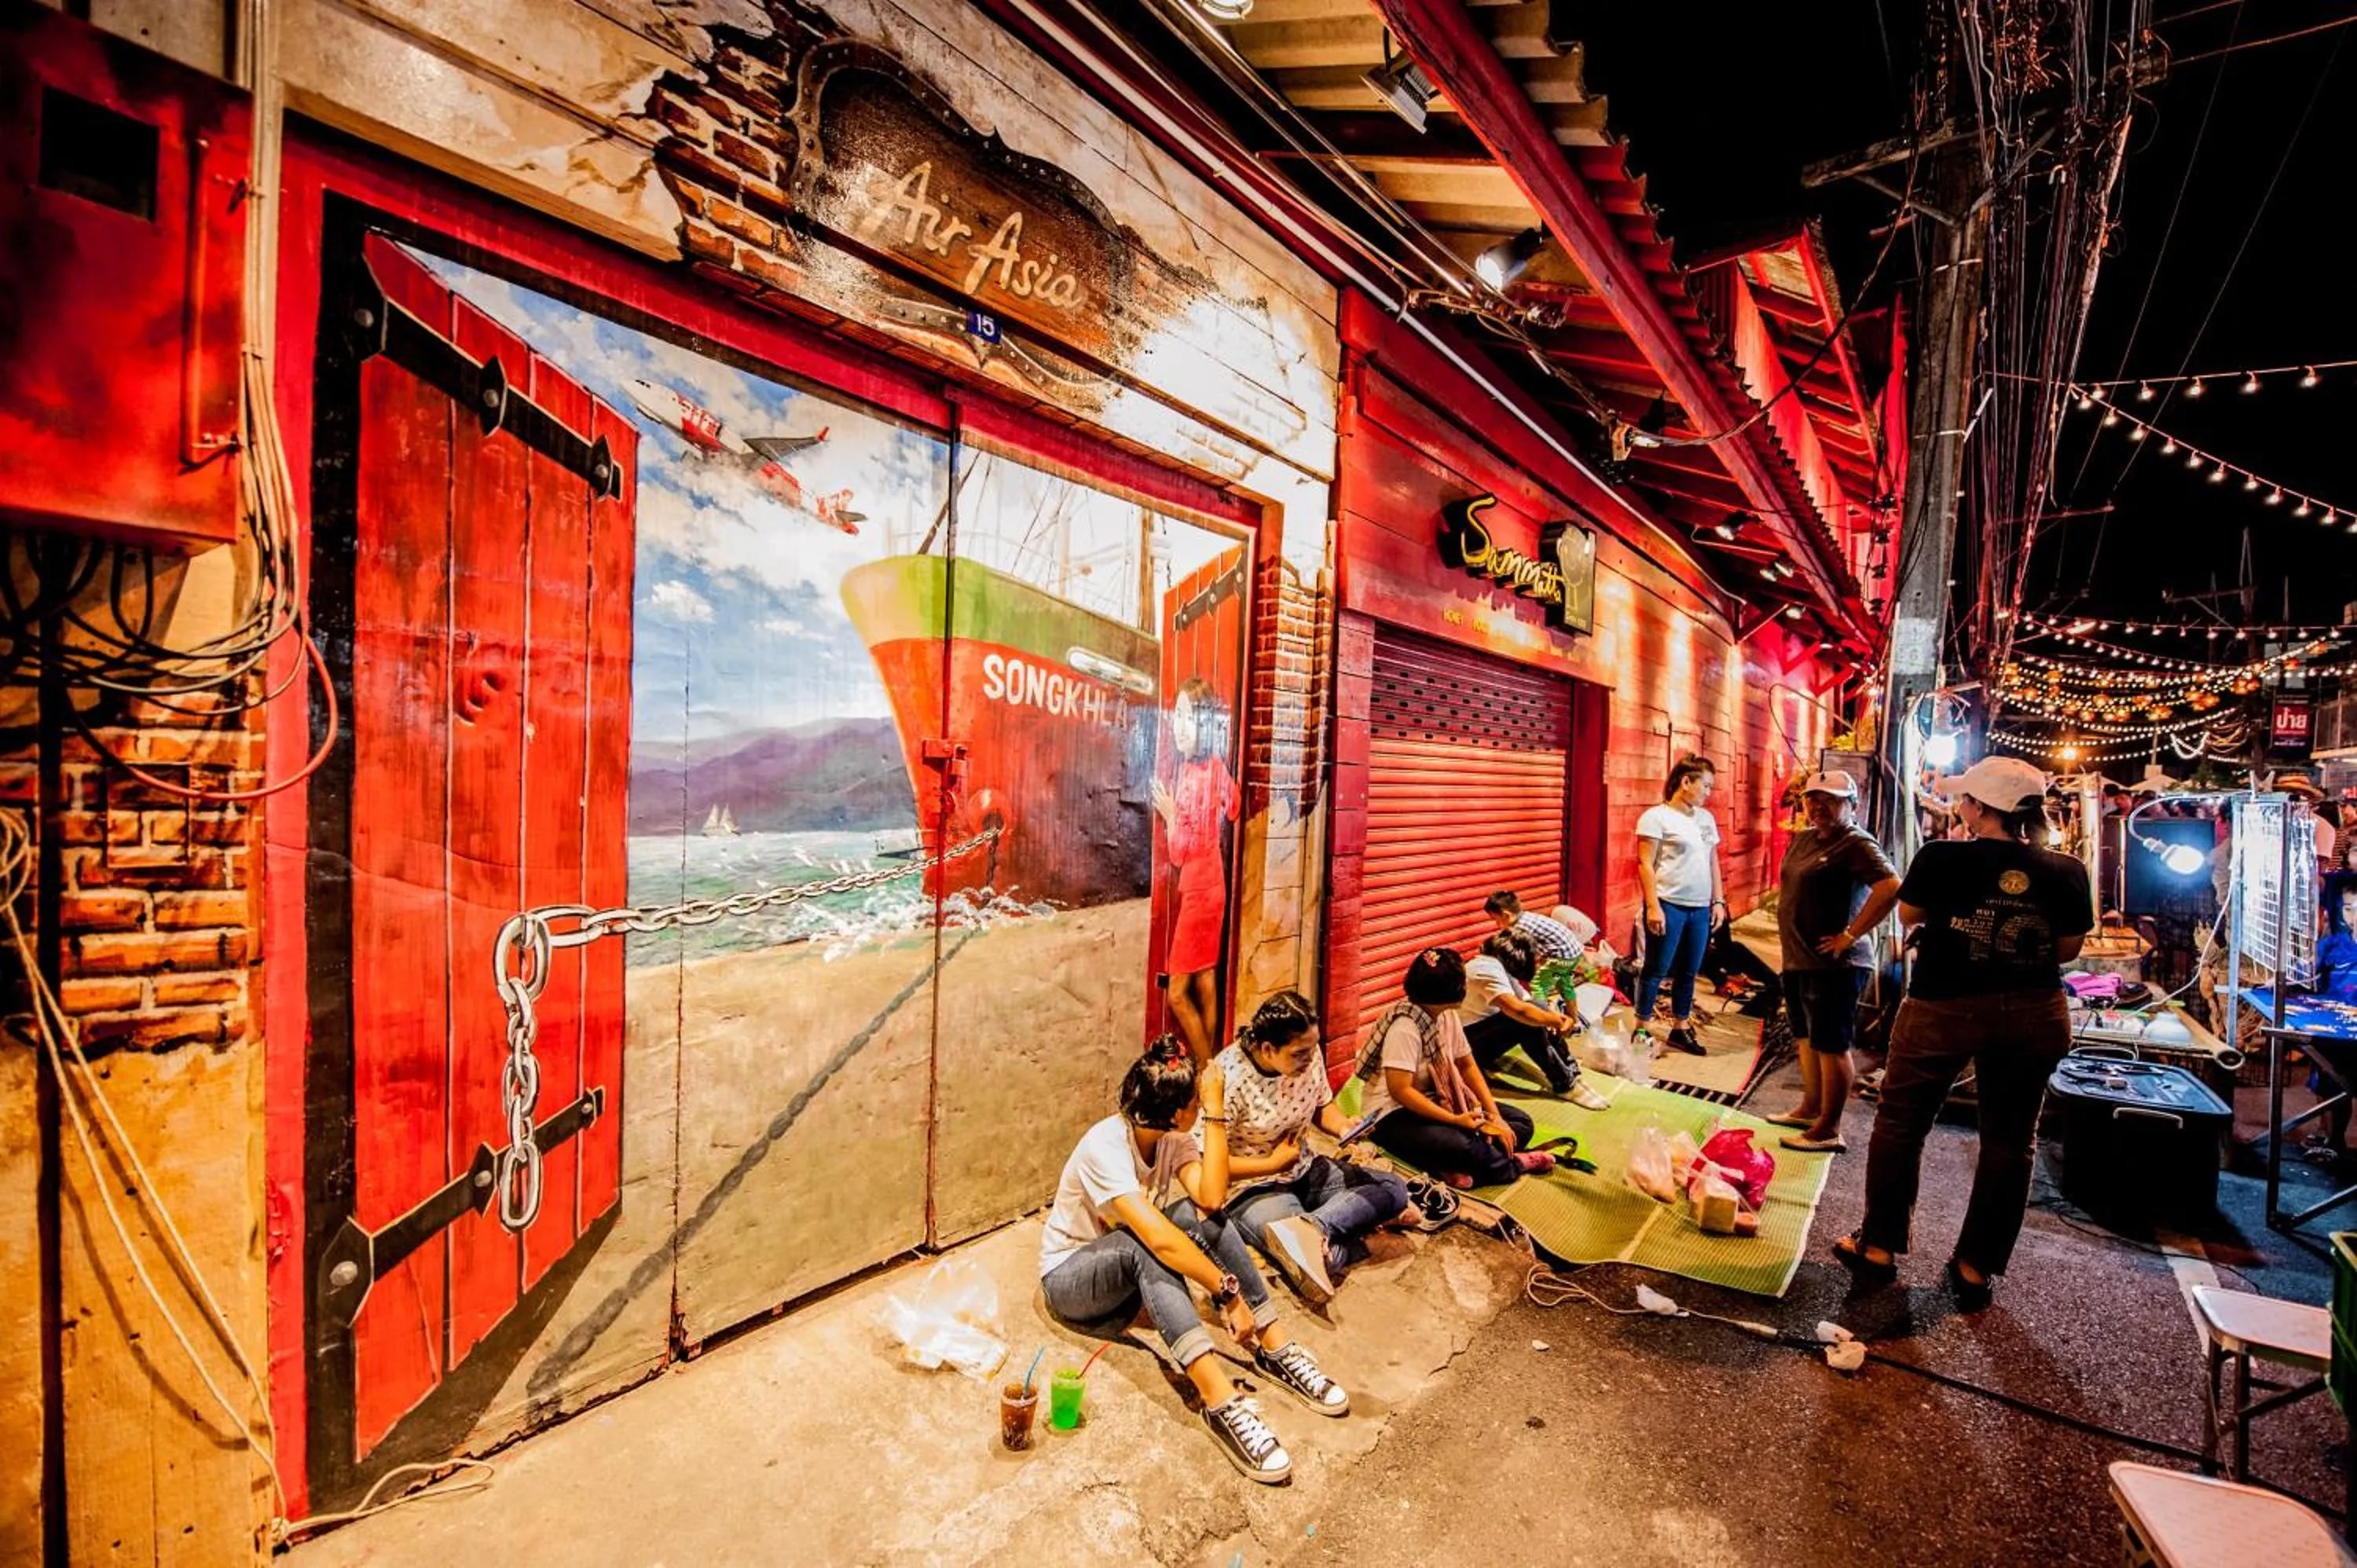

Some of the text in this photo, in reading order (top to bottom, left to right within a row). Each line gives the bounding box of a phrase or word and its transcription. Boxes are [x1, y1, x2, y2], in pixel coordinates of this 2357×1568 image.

[856, 161, 1085, 308] Air Asia
[976, 313, 995, 337] 15
